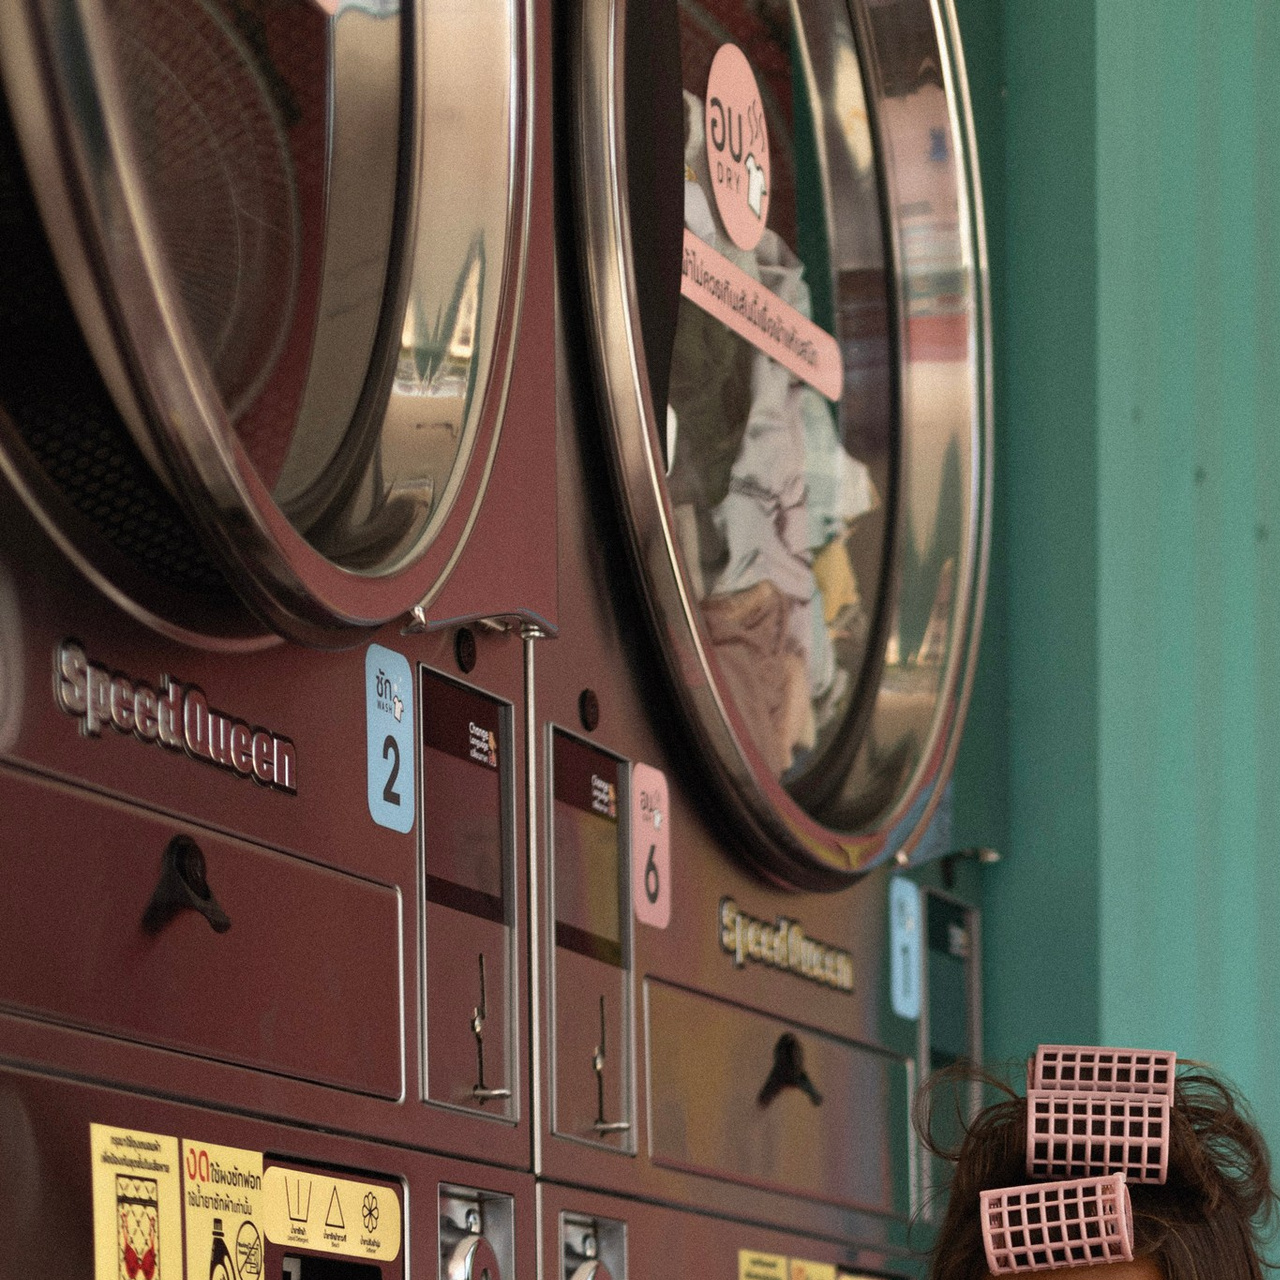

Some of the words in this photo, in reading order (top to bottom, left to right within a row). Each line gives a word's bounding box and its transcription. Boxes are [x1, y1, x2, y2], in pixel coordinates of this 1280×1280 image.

[710, 96, 742, 163] อบ
[717, 161, 740, 194] DRY
[376, 669, 392, 701] ซัก
[377, 701, 392, 715] WASH
[469, 721, 489, 741] Change
[382, 734, 401, 807] 2
[645, 844, 659, 904] 6
